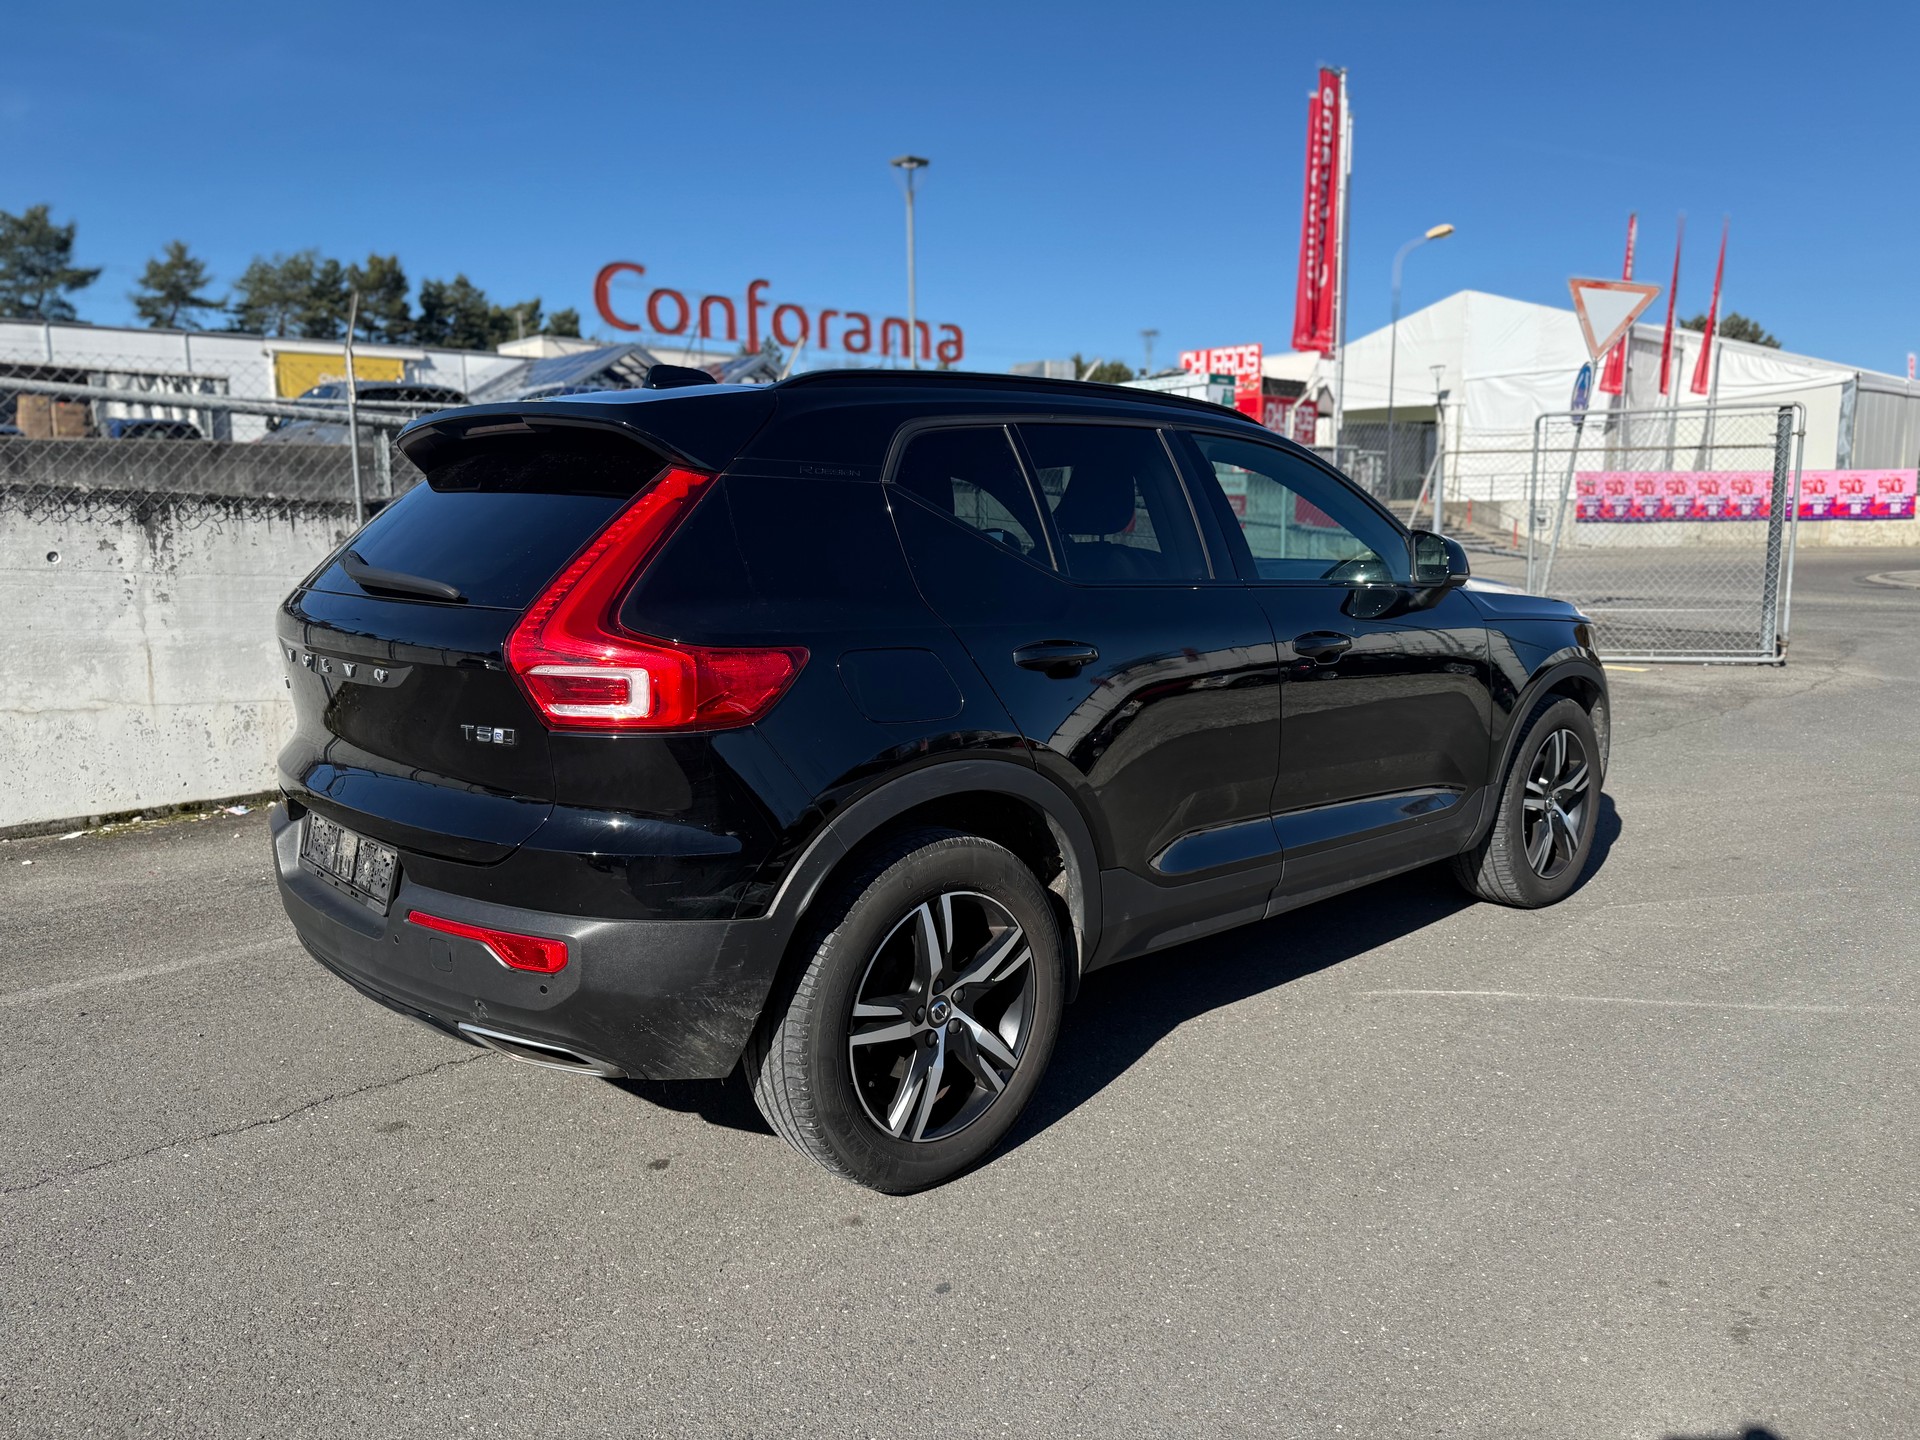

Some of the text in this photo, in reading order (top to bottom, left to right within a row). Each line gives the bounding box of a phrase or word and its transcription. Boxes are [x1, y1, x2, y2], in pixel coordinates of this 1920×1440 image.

[593, 260, 965, 365] Conforama
[1181, 344, 1260, 376] CHURROS
[288, 648, 389, 684] VOLVO
[460, 724, 492, 742] T5
